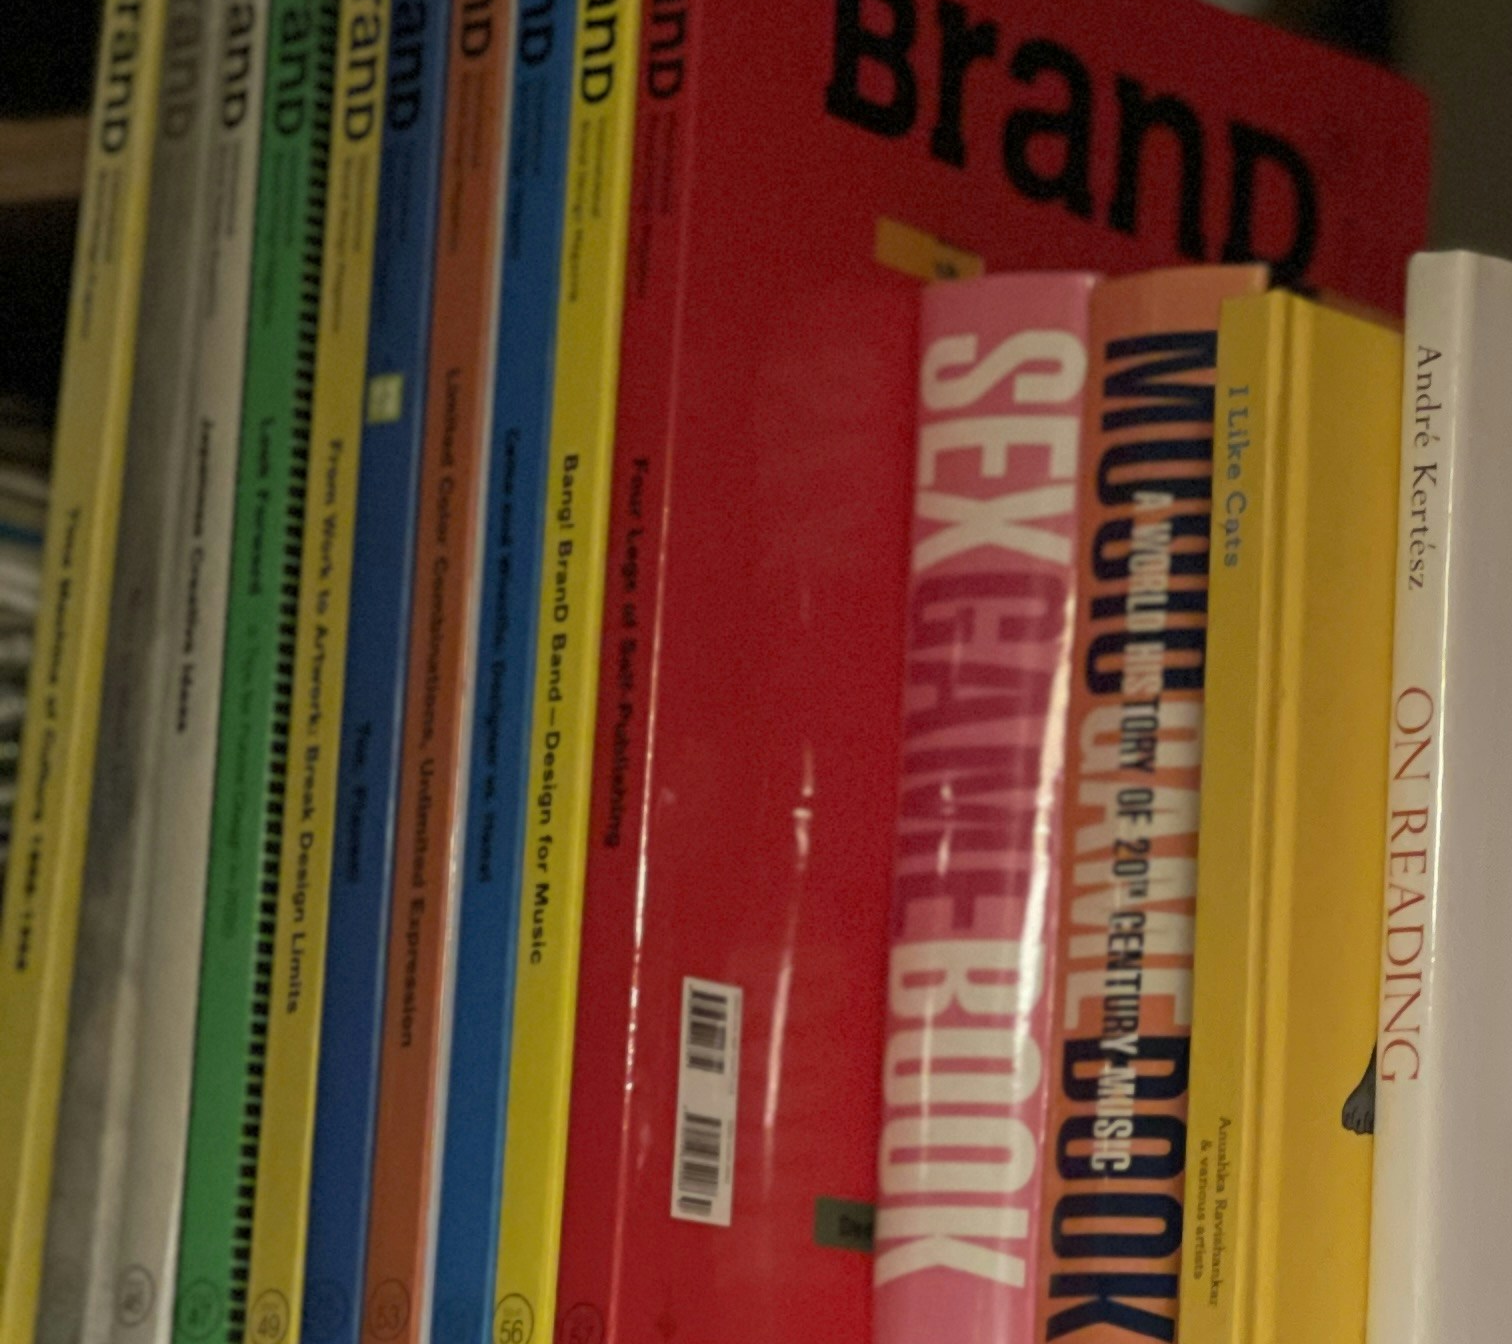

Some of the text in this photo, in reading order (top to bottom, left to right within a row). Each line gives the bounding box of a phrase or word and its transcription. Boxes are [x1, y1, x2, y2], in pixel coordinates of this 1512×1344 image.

[556, 453, 580, 531] Bang!
[627, 457, 649, 519] Four
[912, 329, 1088, 571] SEX
[1133, 491, 1174, 508] A
[1223, 386, 1250, 568] I Like Cats
[1407, 344, 1443, 592] André Kertész
[618, 527, 644, 594] Legs
[1126, 522, 1174, 633] WORLD
[284, 438, 342, 1015] From Work to Artwork: Break Design Limits
[396, 365, 463, 1050] Limited Color Combinations, Unlimited Expression
[1116, 643, 1165, 774] HISTORY
[534, 833, 554, 874] for
[1045, 330, 1217, 1343] MUSIC GAME BOOK
[1116, 787, 1155, 826] OF
[528, 882, 551, 966] Music
[1380, 686, 1434, 1083] ON READING
[1099, 911, 1146, 1055] CENTURY
[874, 939, 1044, 1289] BOOK
[1090, 1068, 1136, 1171] MUSIC
[1193, 1138, 1211, 1281] & various artists
[1208, 1115, 1232, 1309] Anushka Ravishankar
[498, 1319, 524, 1344] 56
